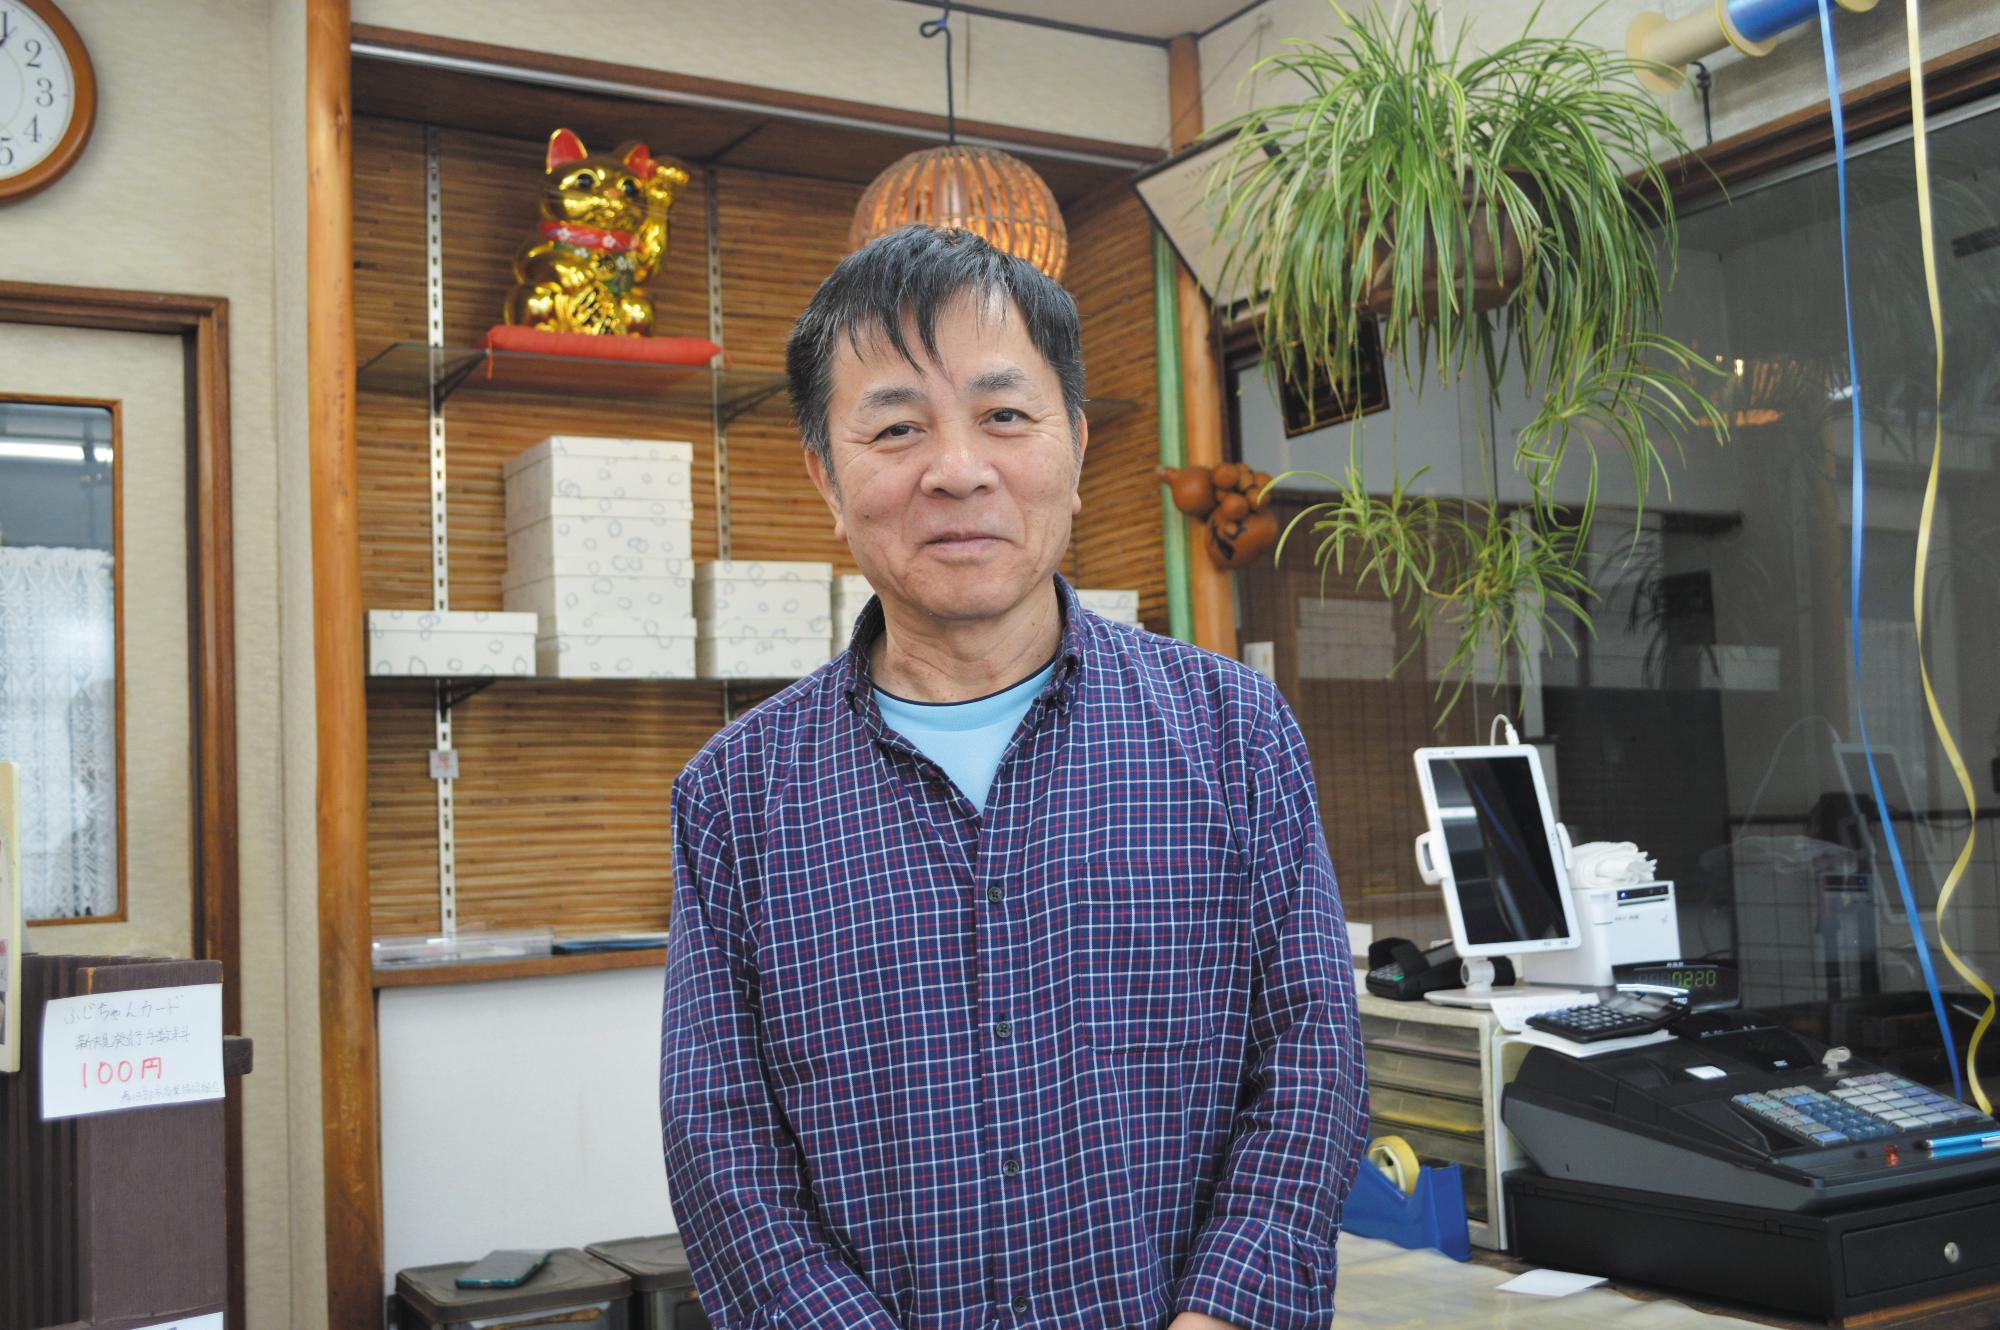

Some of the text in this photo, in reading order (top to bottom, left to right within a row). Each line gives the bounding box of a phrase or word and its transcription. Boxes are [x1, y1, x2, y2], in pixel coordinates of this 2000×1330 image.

[24, 39, 42, 69] 2
[36, 77, 54, 108] 3
[24, 114, 42, 144] 4
[64, 994, 184, 1024] ふじちゃんカード
[75, 1024, 192, 1051] 新規発行手数料
[81, 1056, 163, 1089] 100円
